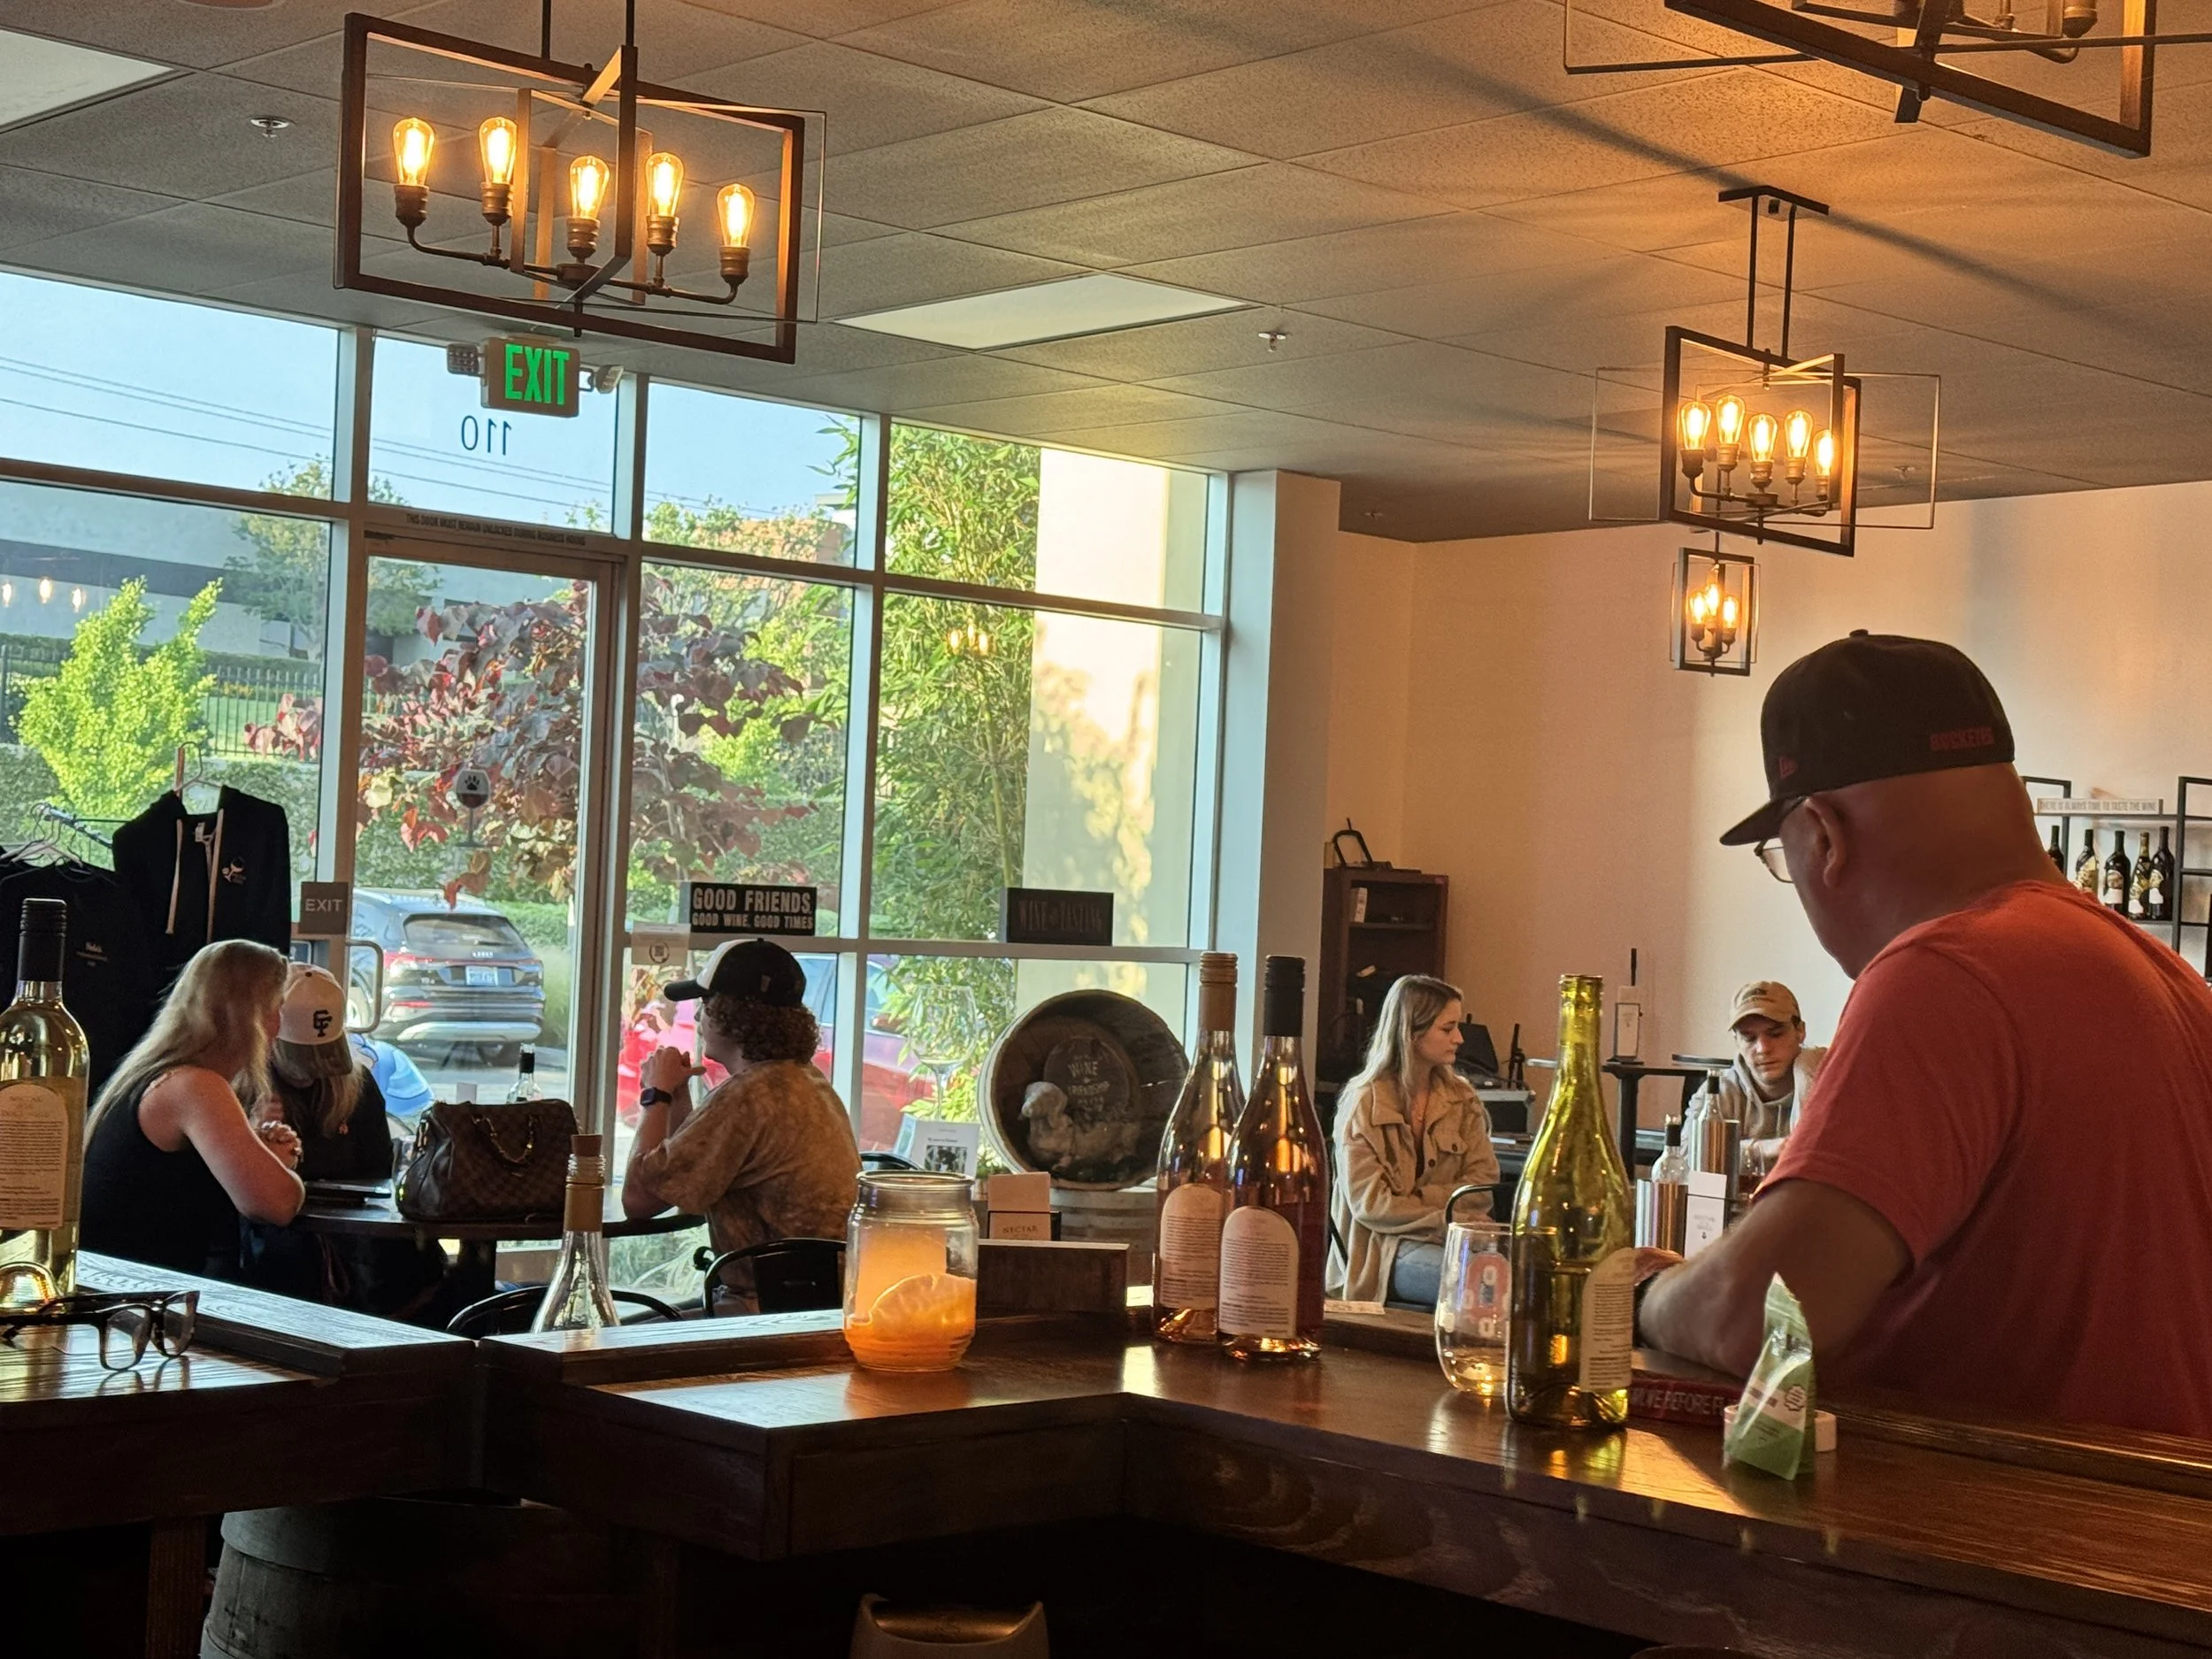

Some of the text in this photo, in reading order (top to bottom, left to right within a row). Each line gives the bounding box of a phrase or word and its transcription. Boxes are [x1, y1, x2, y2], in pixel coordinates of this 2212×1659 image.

[505, 343, 570, 405] EXIT
[305, 898, 343, 912] EXIT
[693, 887, 737, 910] GOOD
[692, 912, 719, 926] GOOD
[754, 915, 780, 928] GOOD
[784, 916, 812, 930] TIMES
[1002, 1225, 1038, 1234] NECTAR
